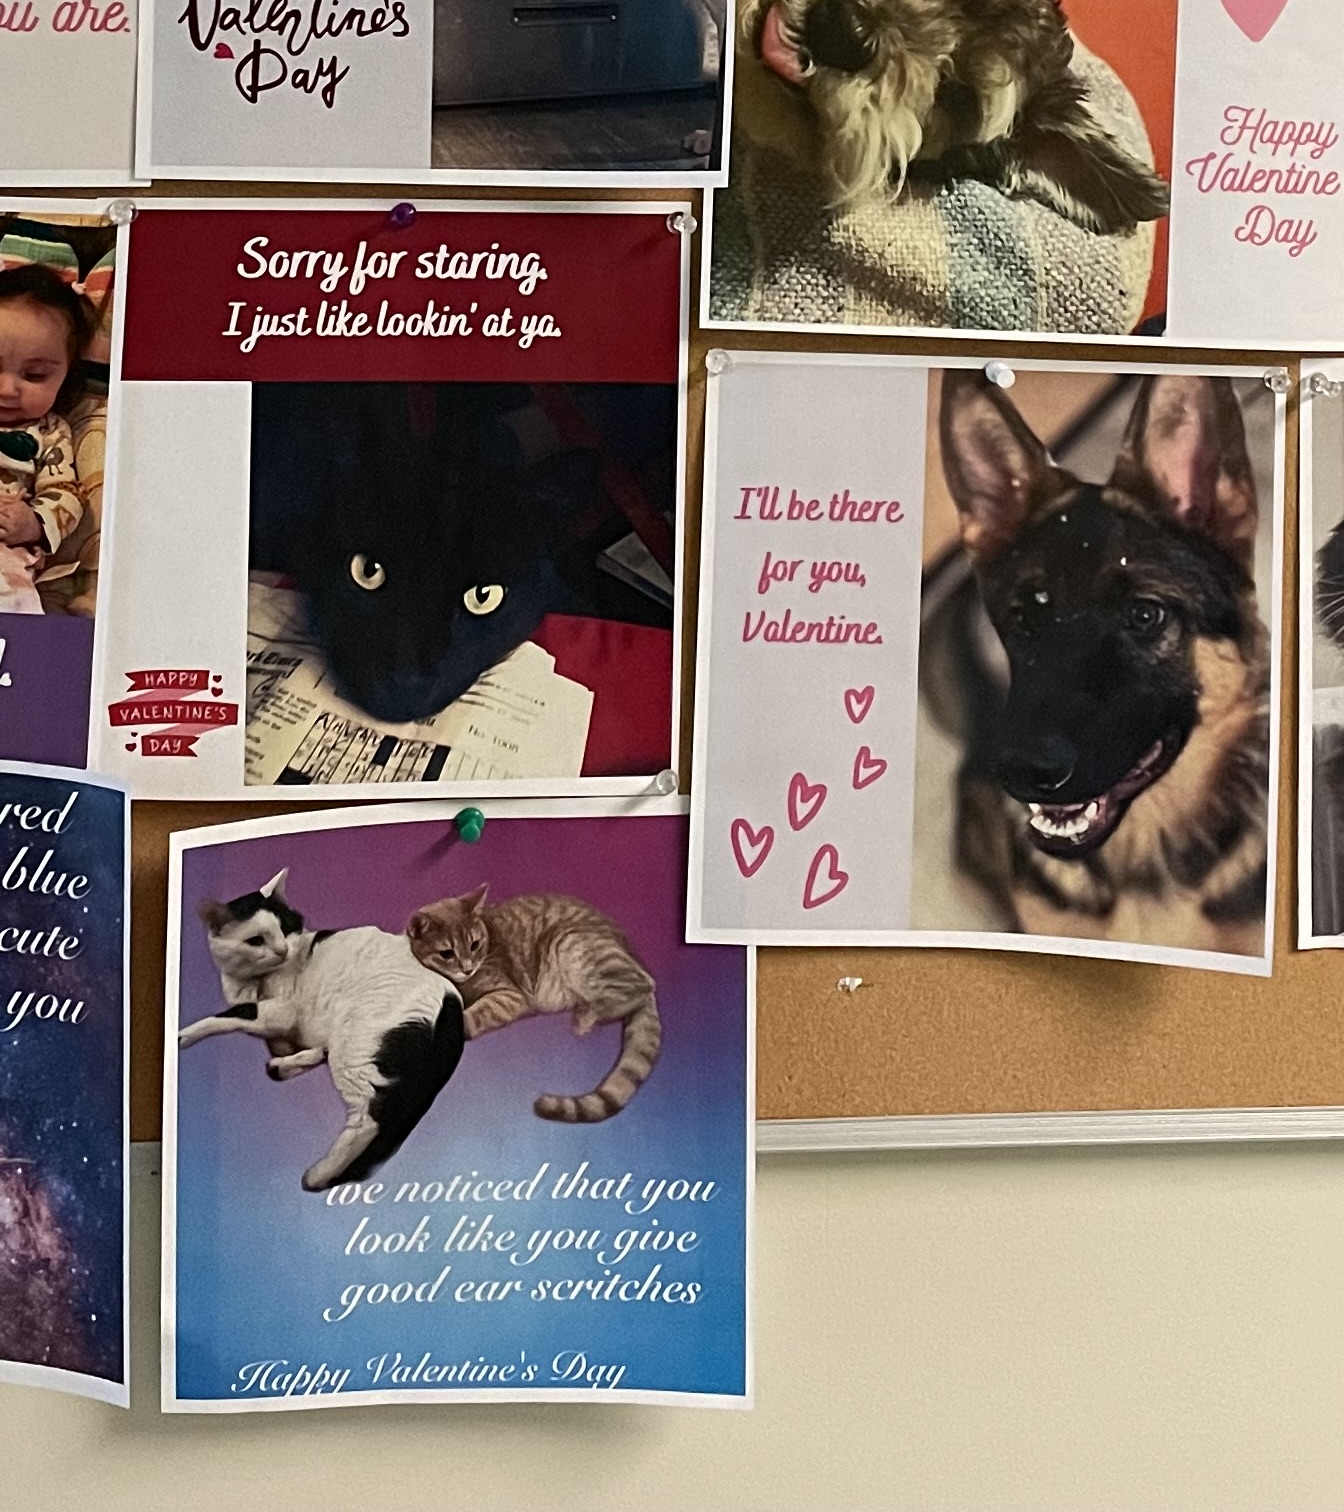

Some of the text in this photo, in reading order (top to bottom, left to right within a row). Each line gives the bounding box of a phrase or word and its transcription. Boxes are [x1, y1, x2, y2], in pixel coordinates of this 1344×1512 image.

[235, 39, 350, 108] Day
[1220, 105, 1339, 160] Happy
[1234, 205, 1317, 257] Day
[237, 236, 407, 295] Sorry for
[222, 300, 516, 353] I just like lookin' at
[787, 489, 904, 523] be there
[758, 552, 866, 594] for you,
[145, 673, 198, 687] HAPPY
[119, 705, 227, 721] VALENTINE'S
[150, 739, 182, 753] DAY
[1, 846, 91, 900] blue
[394, 1162, 722, 1214] noticed that you
[345, 1214, 702, 1265] look like you give
[322, 1264, 703, 1322] good ear scritches
[366, 1349, 627, 1389] Valentine's Day
